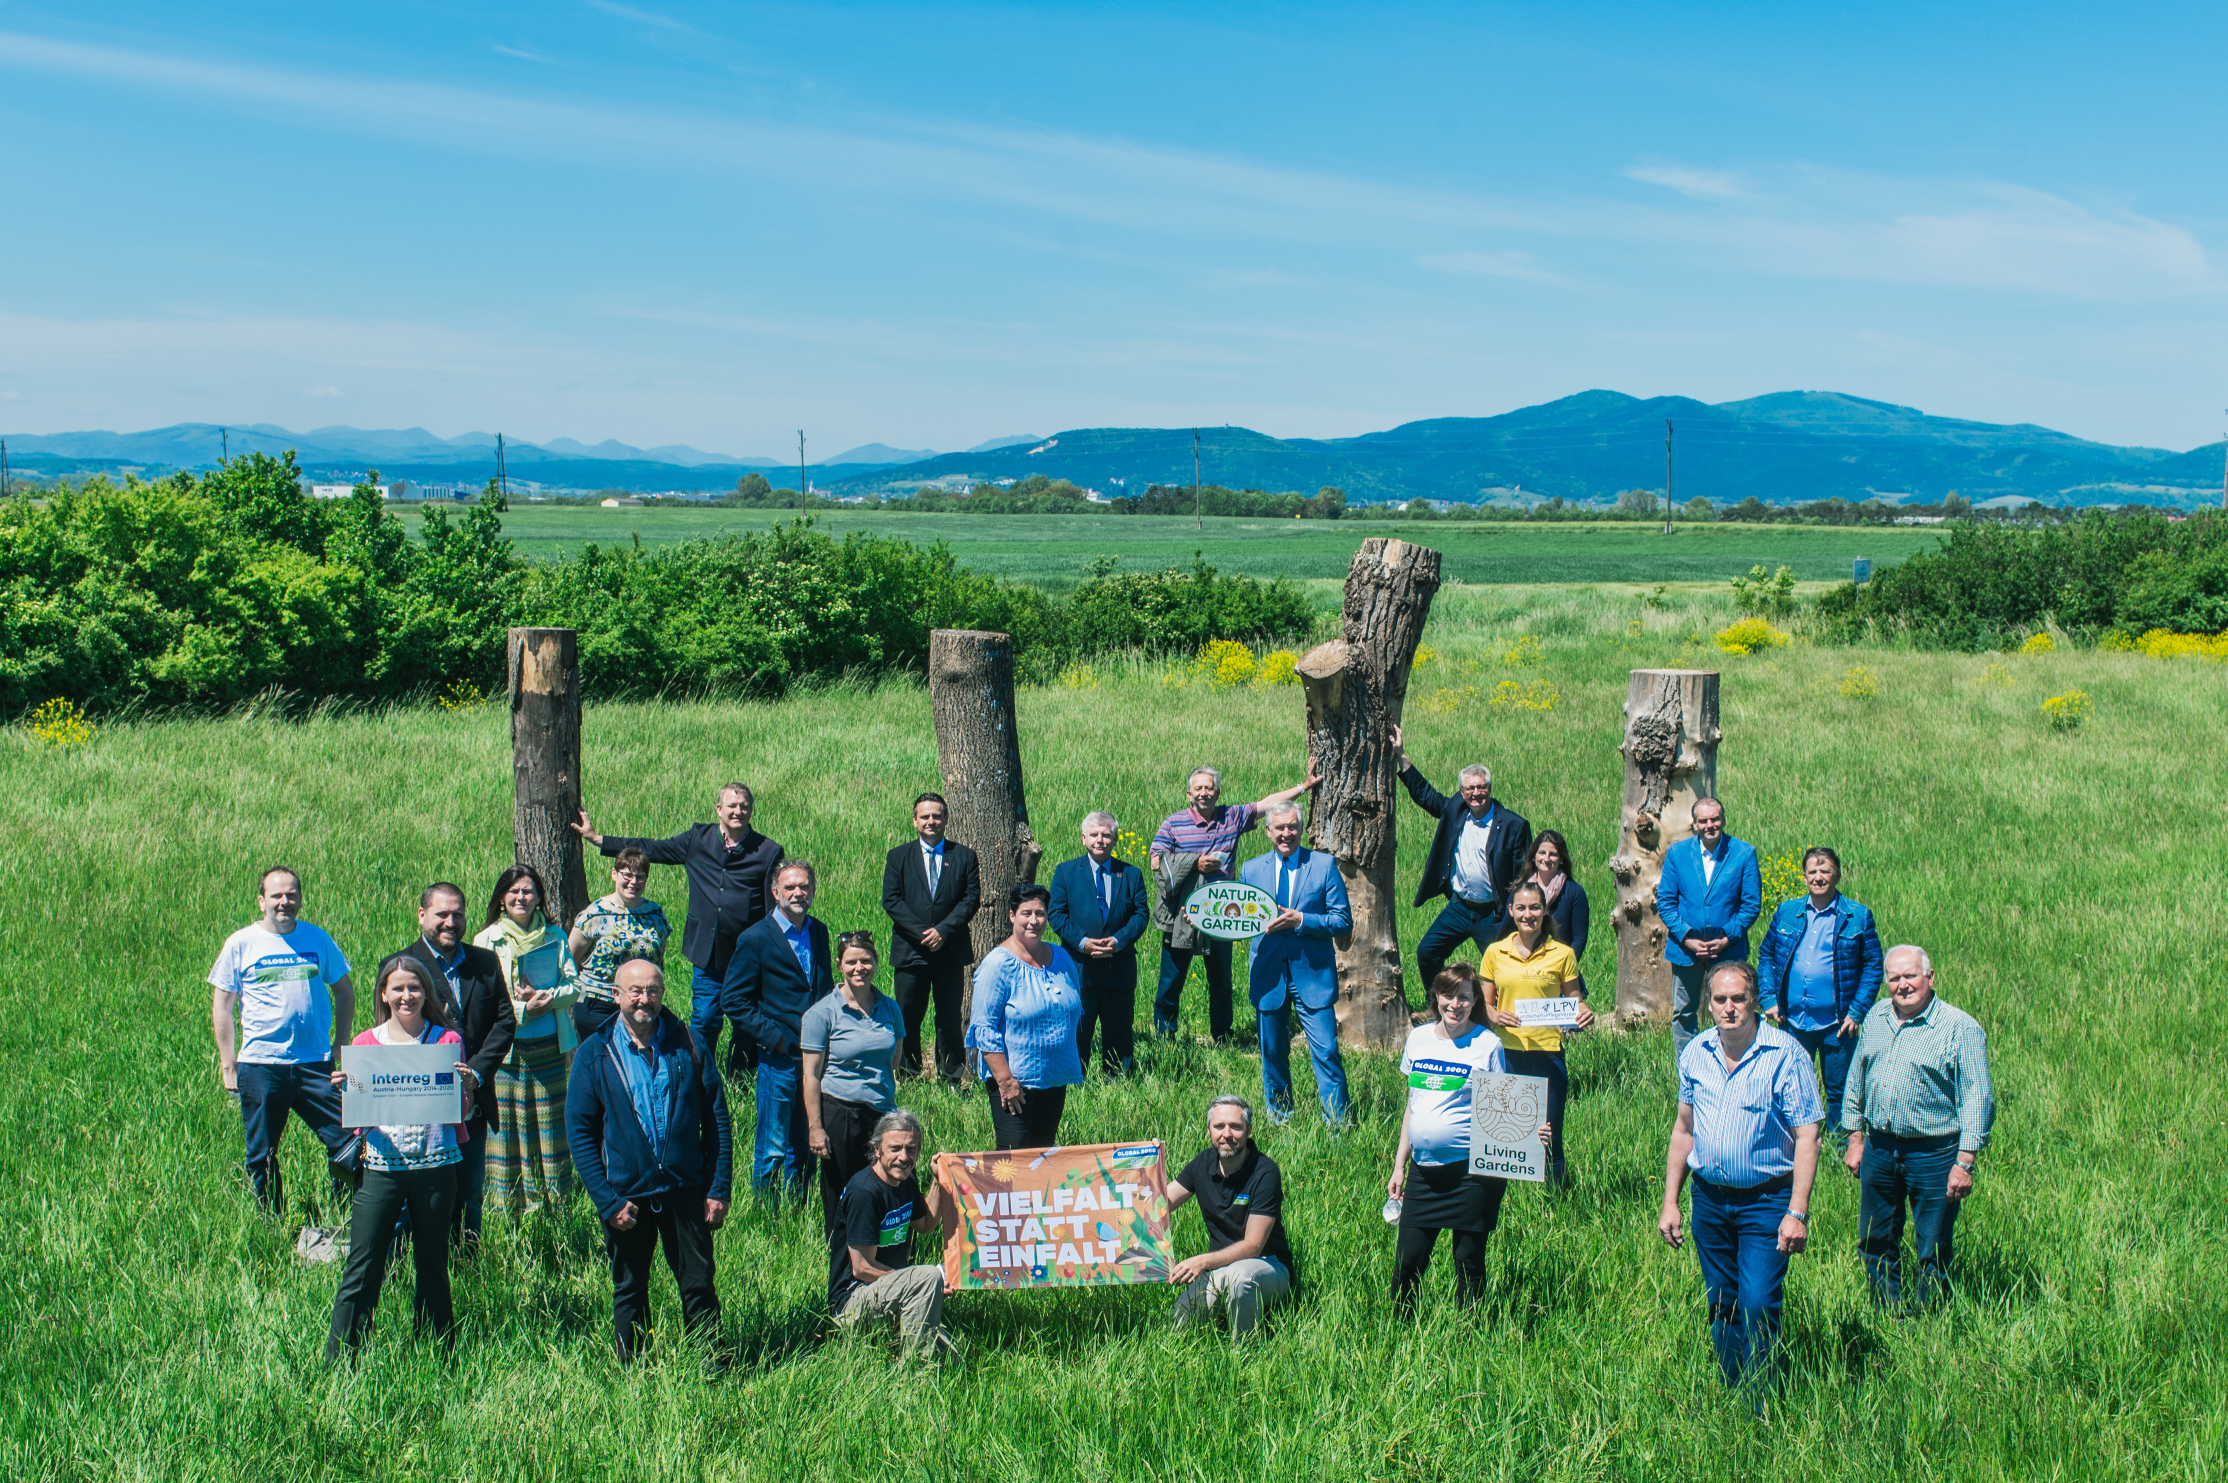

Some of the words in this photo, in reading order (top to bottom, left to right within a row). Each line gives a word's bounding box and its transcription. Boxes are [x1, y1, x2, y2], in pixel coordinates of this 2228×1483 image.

[1208, 888, 1257, 901] NATUR
[1202, 918, 1260, 932] GARTEN
[260, 958, 294, 966] GLOBAL
[296, 956, 318, 964] 2000
[1553, 1000, 1576, 1012] LPV
[1414, 1062, 1443, 1072] GLOBAL
[1445, 1066, 1468, 1075] 2000
[372, 1074, 430, 1085] Interreg
[1484, 1144, 1527, 1162] Living
[1474, 1157, 1535, 1175] Gardens
[973, 1183, 1139, 1216] VIELFALT
[976, 1215, 1090, 1243] STATT
[978, 1240, 1122, 1268] EINFALT
